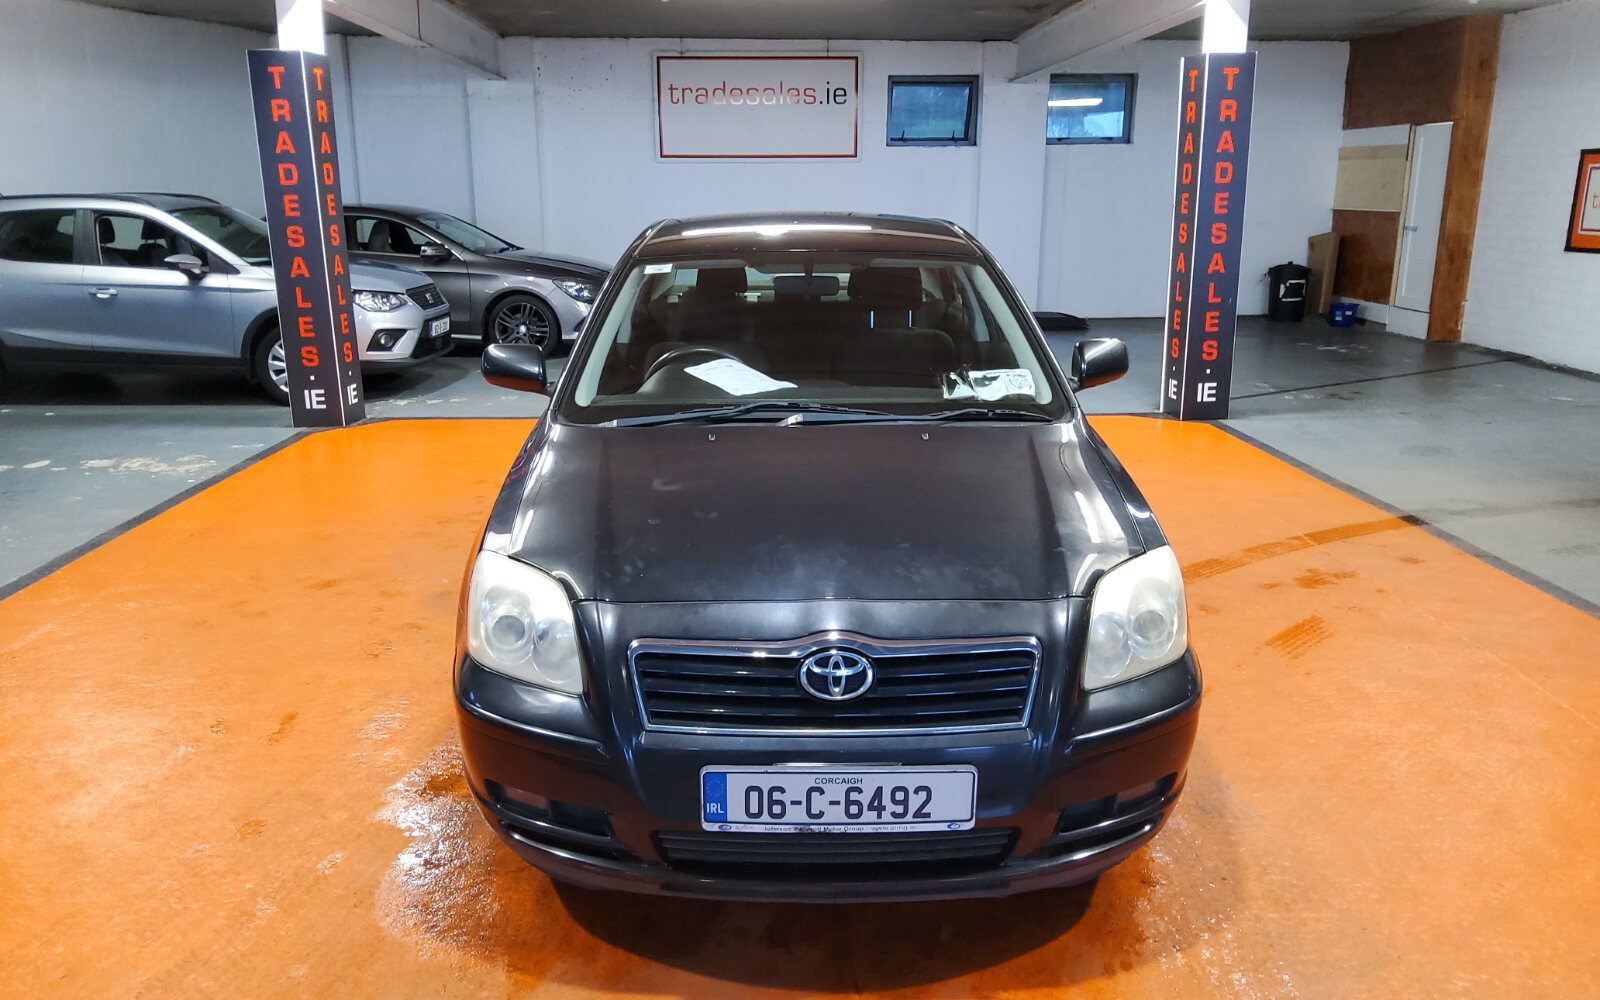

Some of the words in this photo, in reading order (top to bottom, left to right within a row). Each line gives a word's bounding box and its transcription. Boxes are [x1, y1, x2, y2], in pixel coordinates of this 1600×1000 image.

[668, 81, 847, 105] tradesales.ie
[814, 777, 863, 785] CORCAIGH
[706, 802, 725, 814] IRL
[744, 785, 932, 820] 06-C-6492
